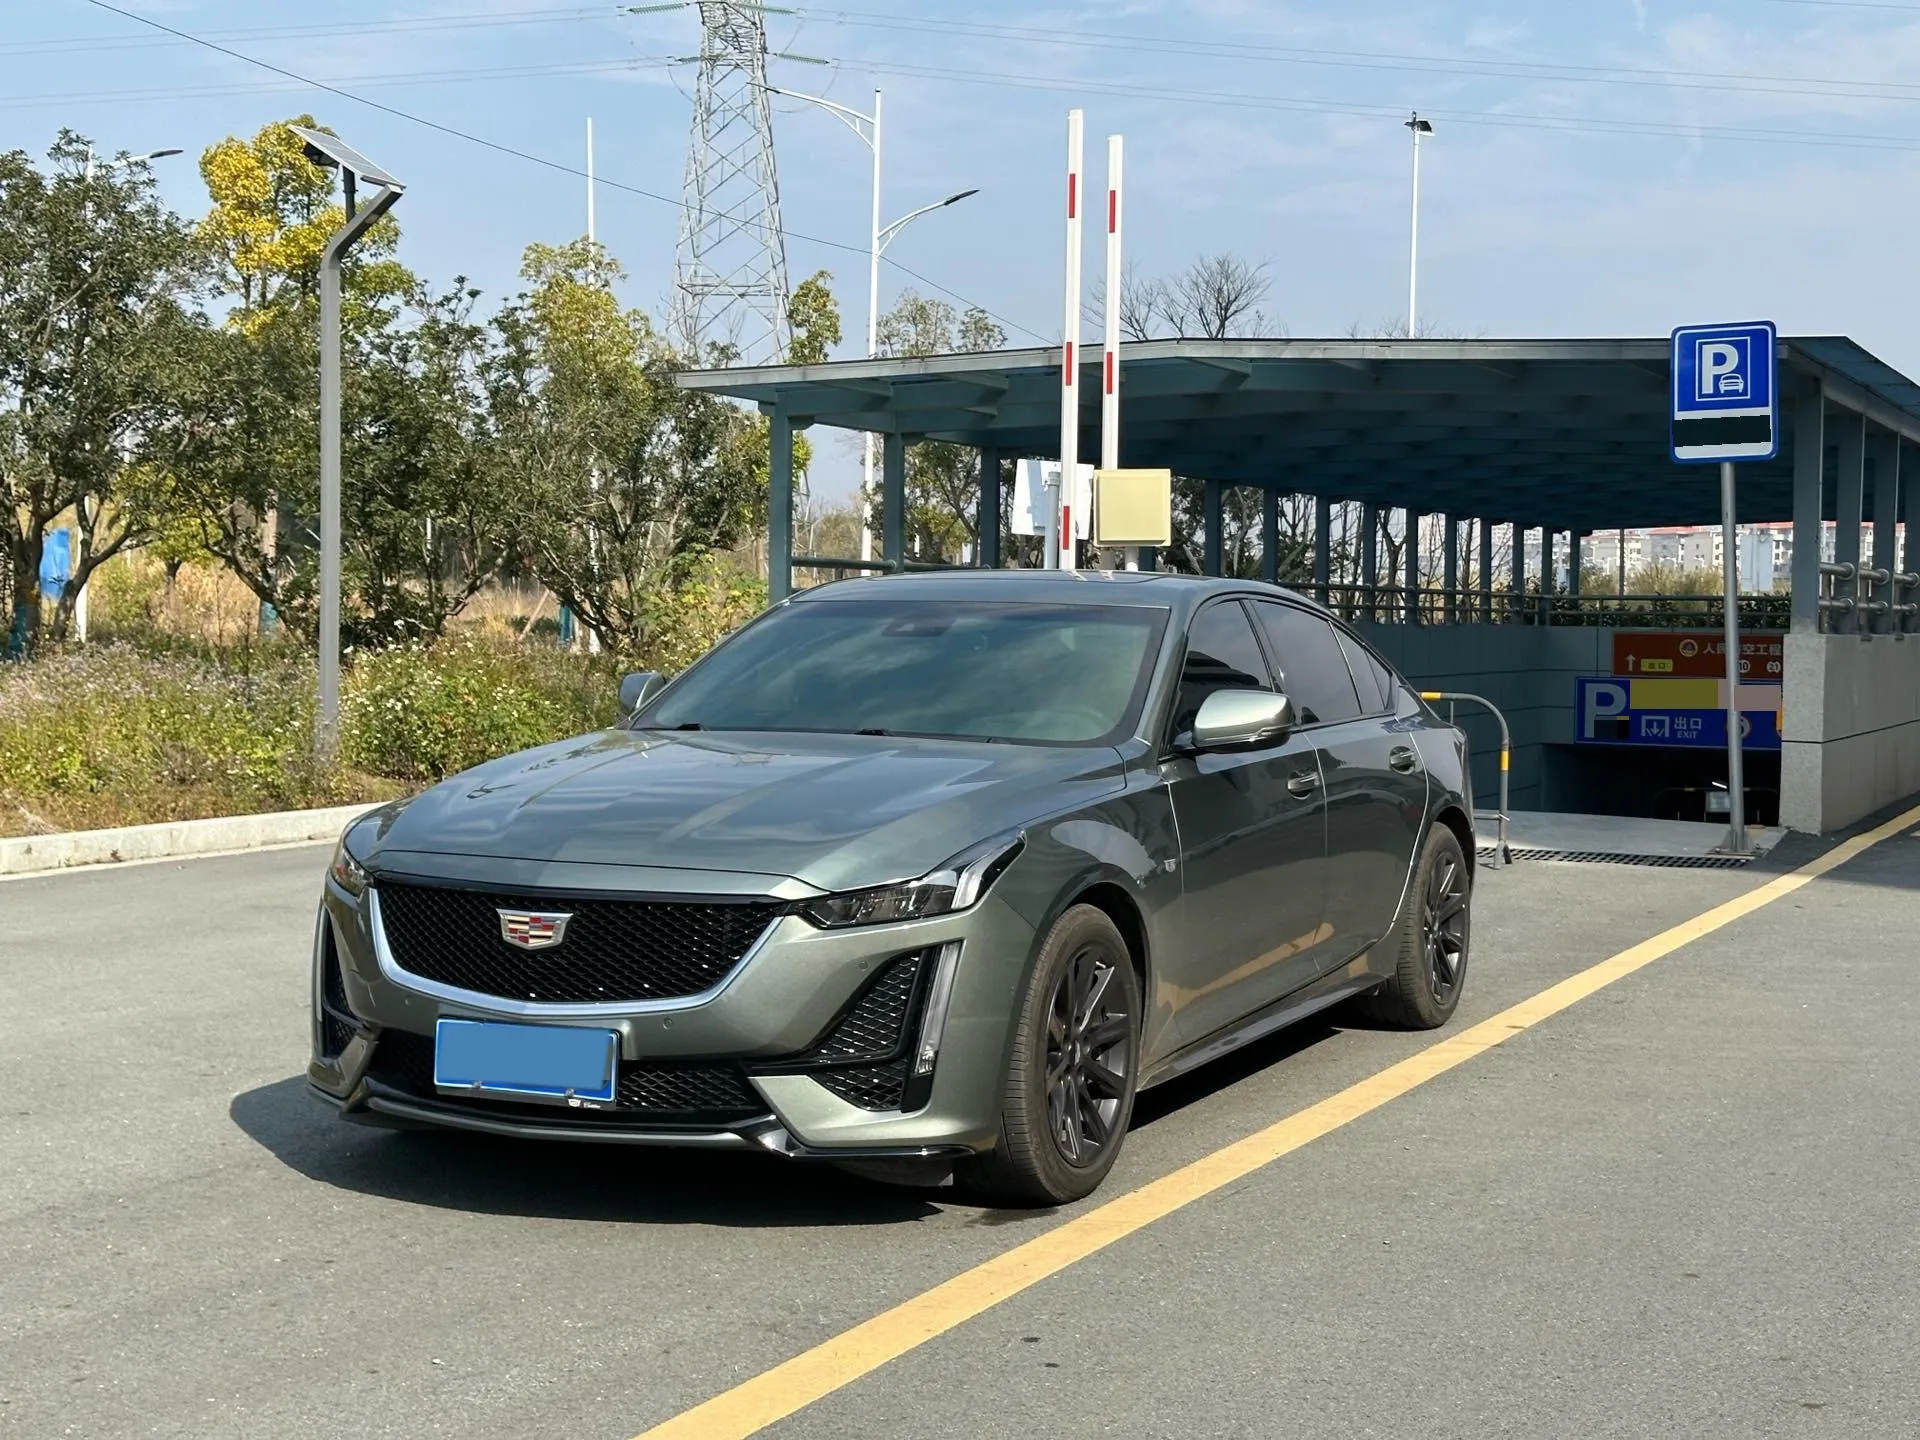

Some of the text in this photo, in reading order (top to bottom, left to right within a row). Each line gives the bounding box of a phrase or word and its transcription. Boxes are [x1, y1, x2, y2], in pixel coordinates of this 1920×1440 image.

[1701, 343, 1739, 394] P
[1702, 642, 1782, 656] 人民空工程
[1584, 683, 1628, 738] P
[1673, 716, 1702, 731] 出口
[1676, 730, 1698, 739] EXIT
